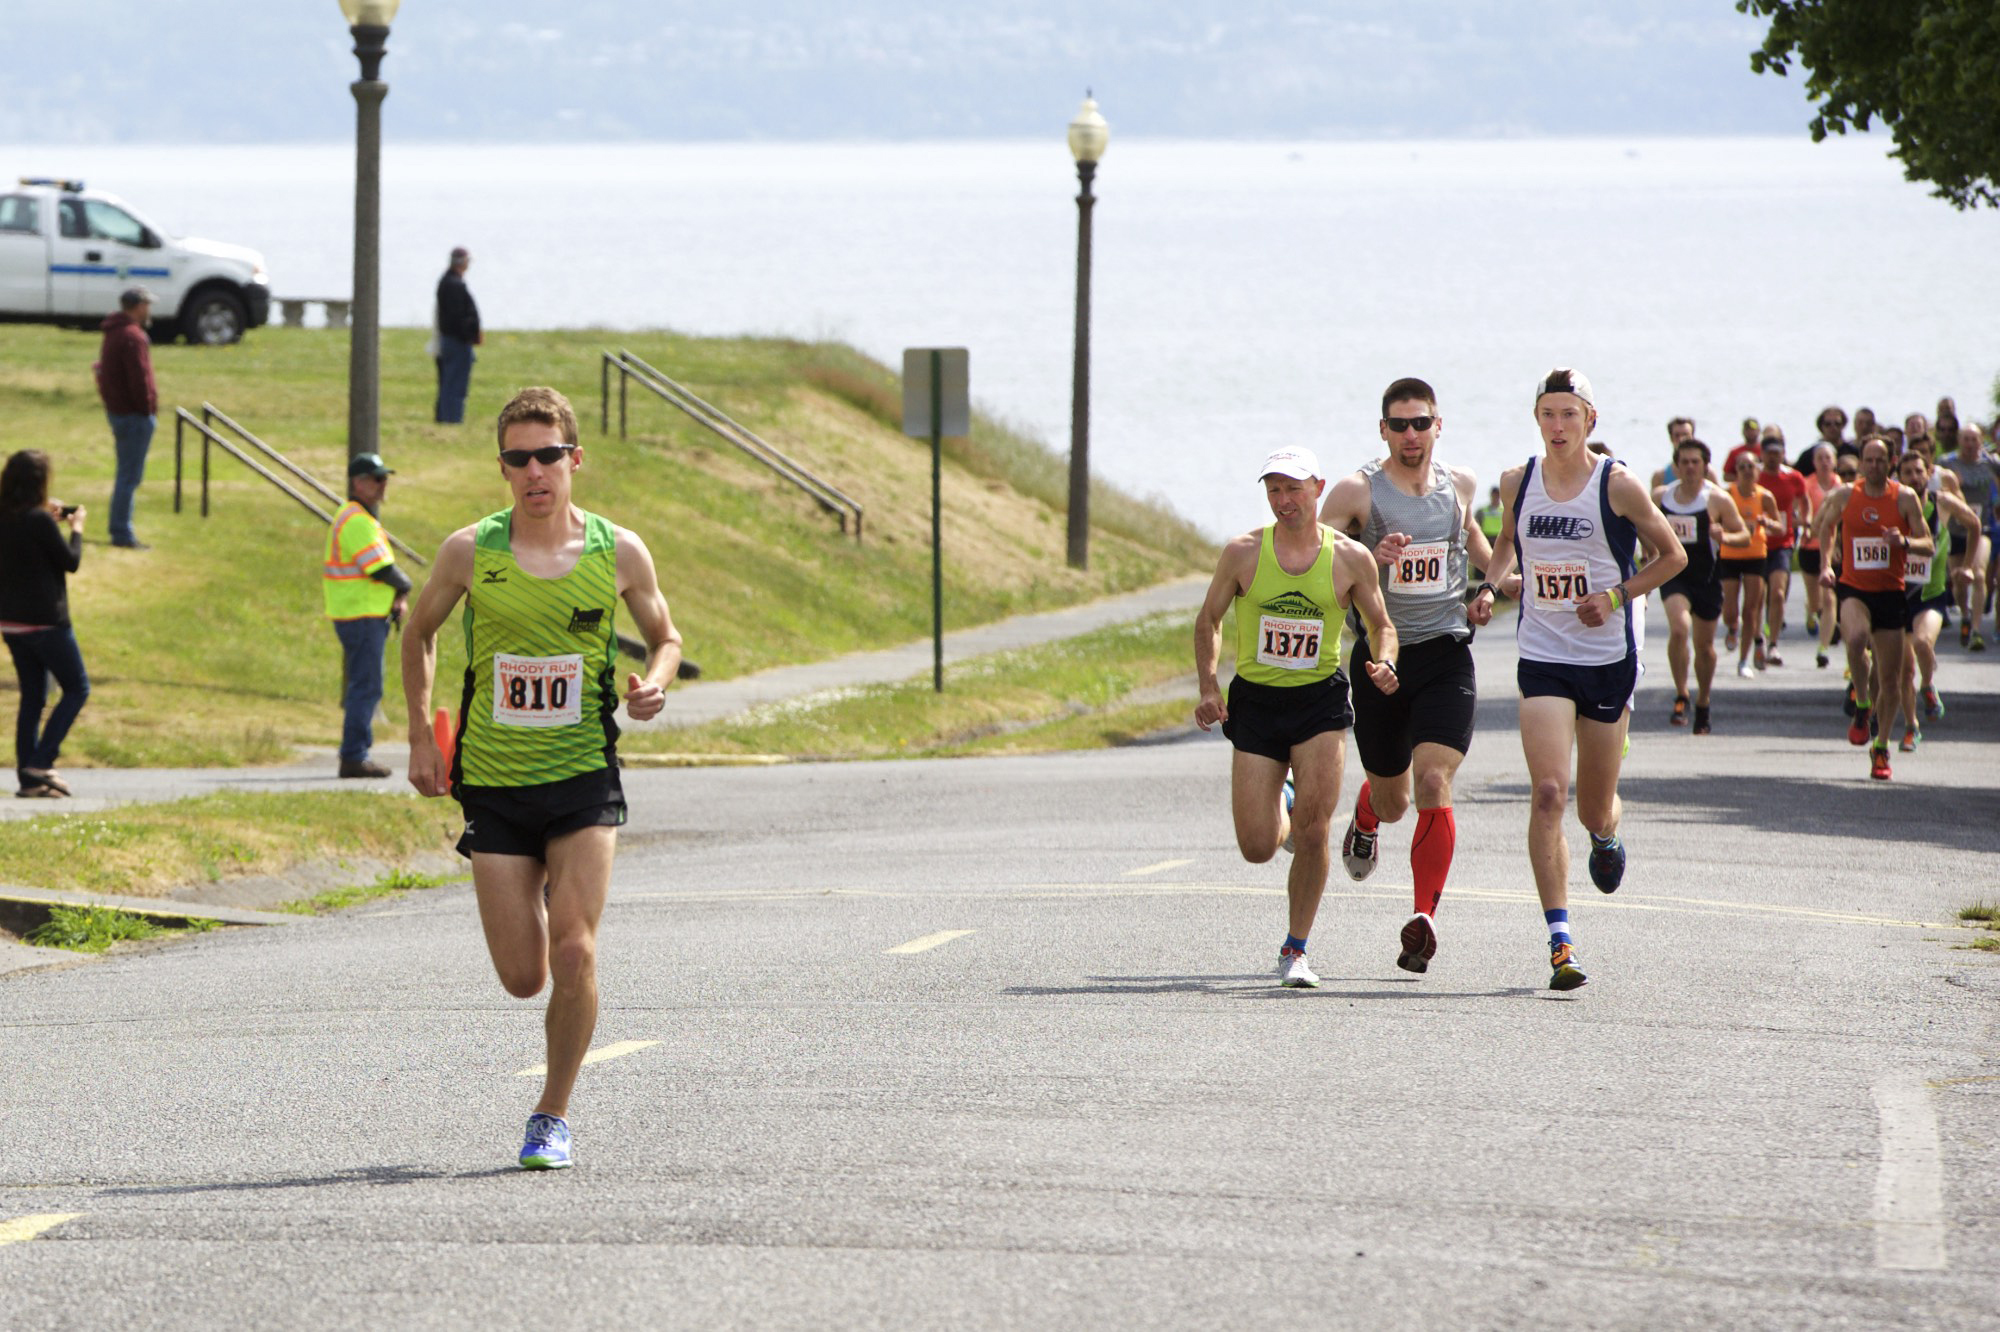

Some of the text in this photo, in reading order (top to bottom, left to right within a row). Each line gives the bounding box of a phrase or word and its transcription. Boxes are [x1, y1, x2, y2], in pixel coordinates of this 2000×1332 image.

[1400, 549, 1425, 557] HODY
[1402, 557, 1440, 582] 890
[1534, 565, 1586, 574] RHODY RUN
[1537, 575, 1589, 599] 1570
[1276, 604, 1325, 618] Seattle
[1264, 620, 1297, 632] RHODY
[1299, 625, 1320, 633] RUN
[1263, 630, 1319, 657] 1376
[499, 662, 578, 674] RHODY RUN
[510, 676, 568, 710] 810
